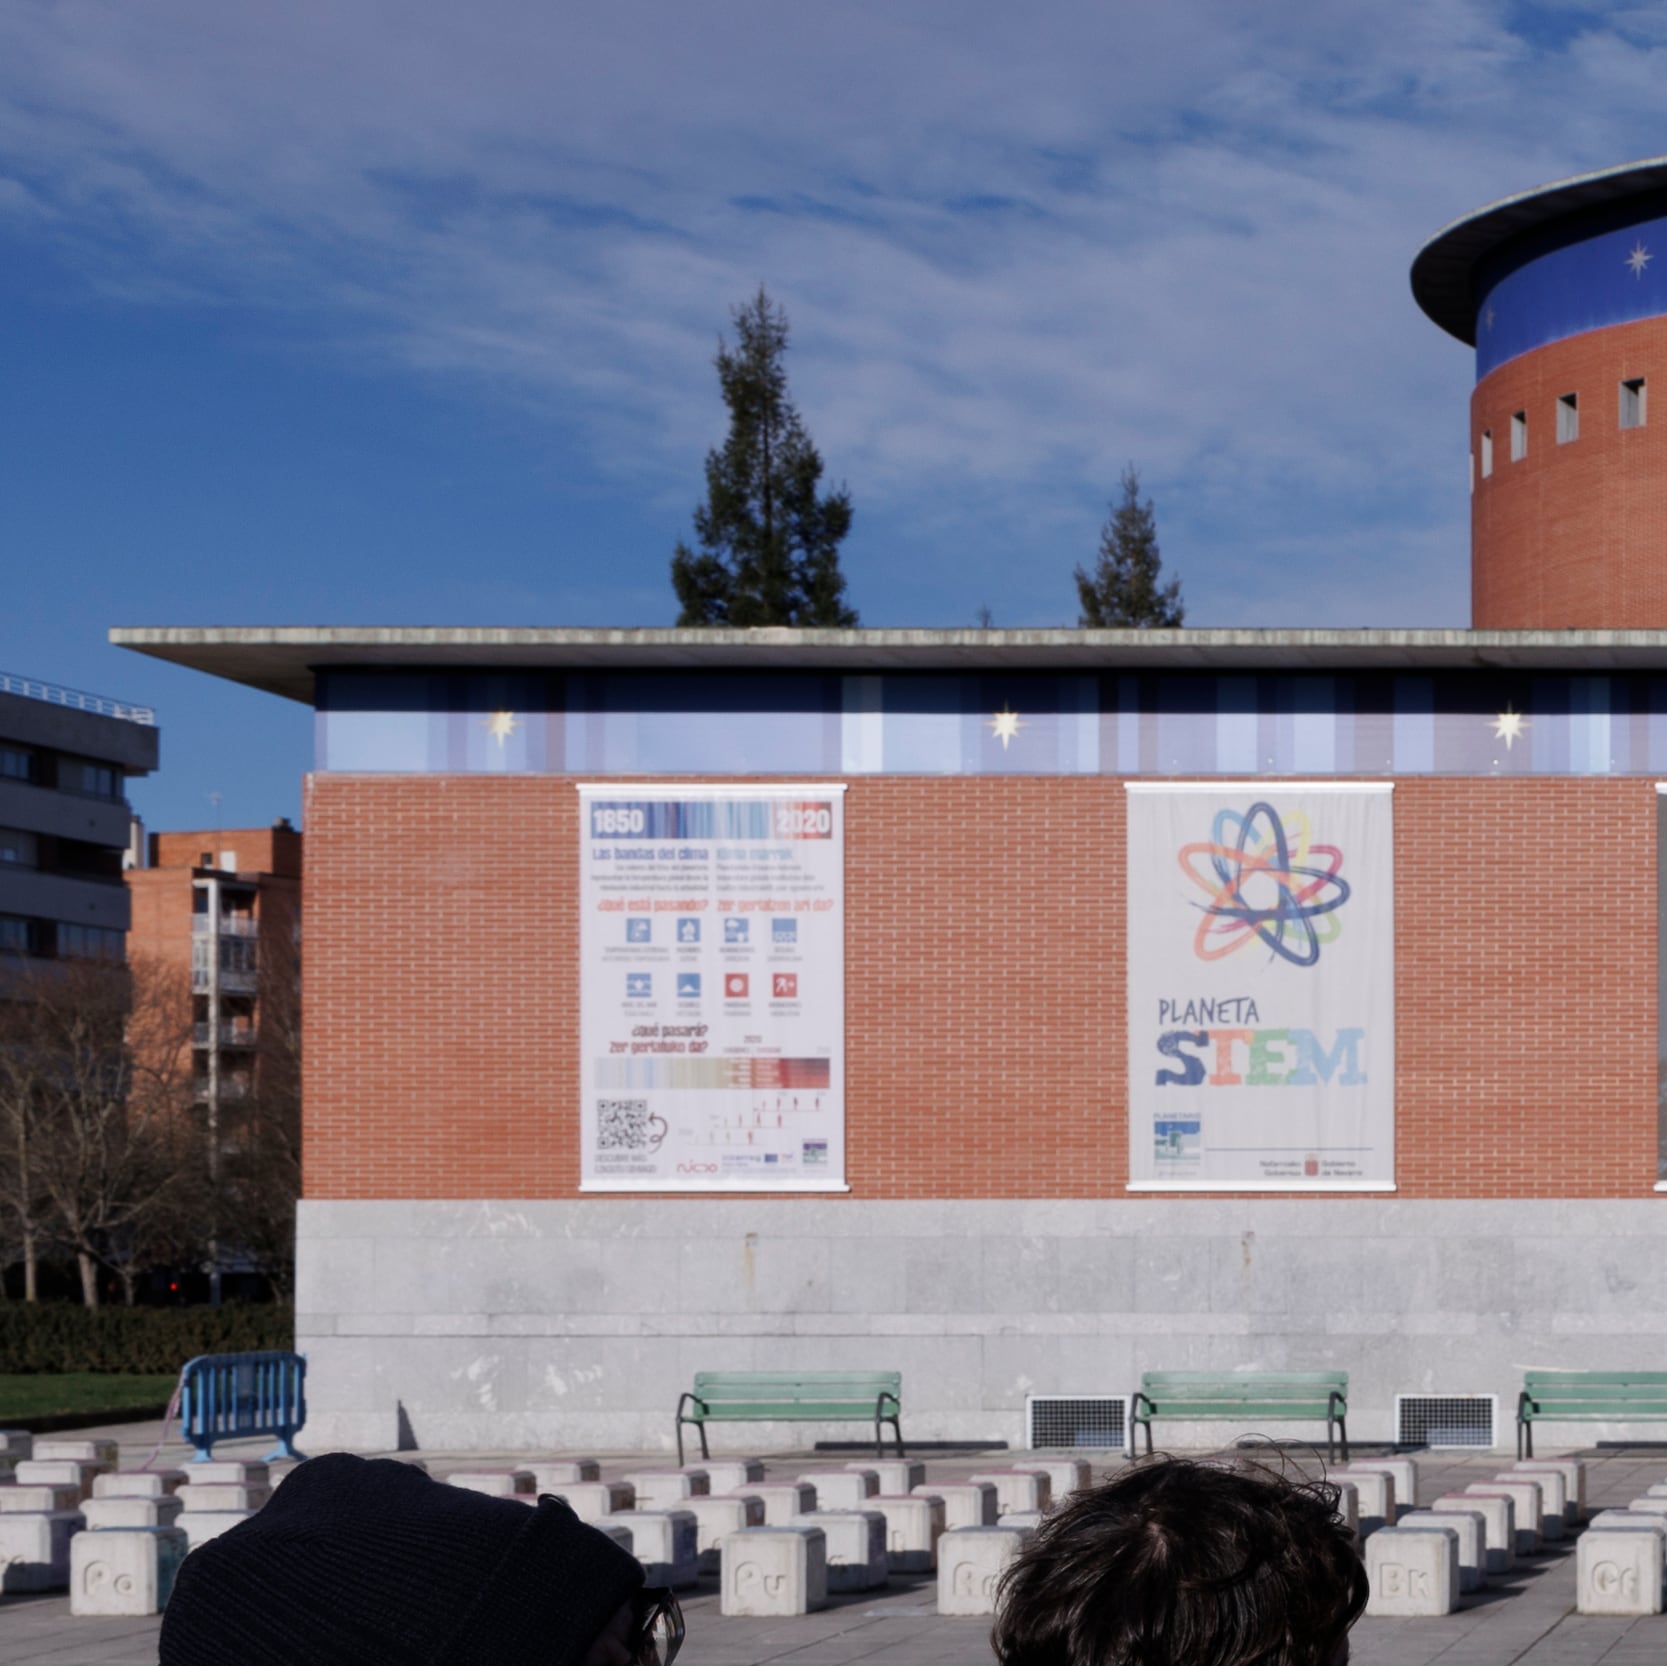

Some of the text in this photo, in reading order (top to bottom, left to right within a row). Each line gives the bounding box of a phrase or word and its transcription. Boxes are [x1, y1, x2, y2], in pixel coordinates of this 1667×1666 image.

[593, 808, 645, 834] 1850
[776, 808, 831, 834] 2020
[658, 848, 675, 861] del
[678, 848, 709, 861] clima
[1158, 996, 1259, 1025] PLANETA
[1155, 1027, 1368, 1087] STEM
[1380, 1562, 1429, 1599] Bk
